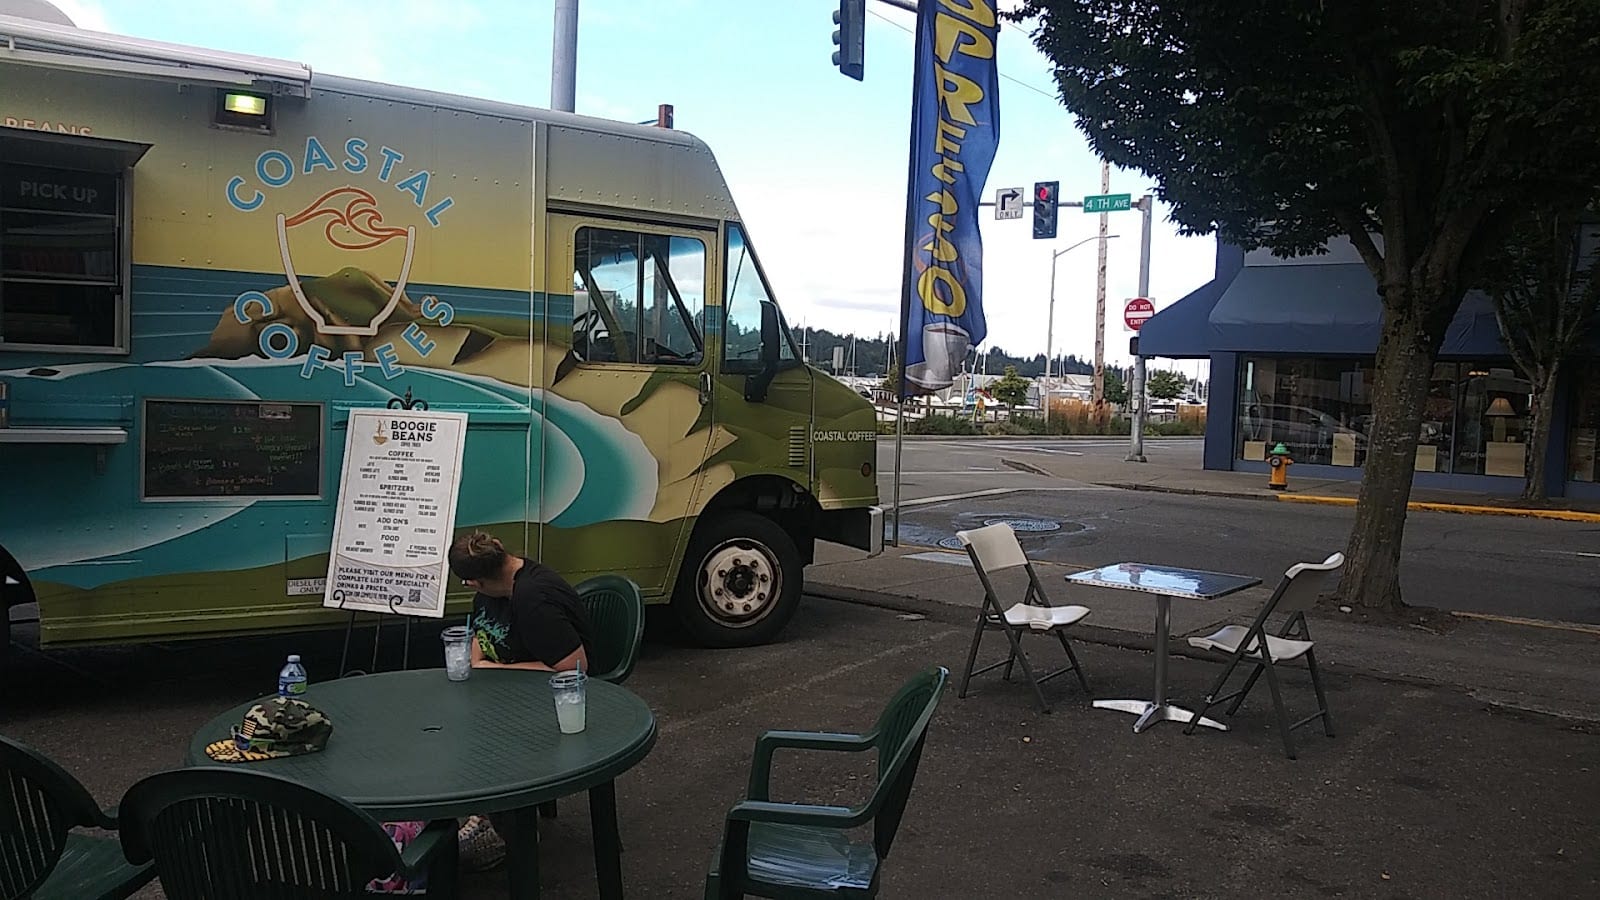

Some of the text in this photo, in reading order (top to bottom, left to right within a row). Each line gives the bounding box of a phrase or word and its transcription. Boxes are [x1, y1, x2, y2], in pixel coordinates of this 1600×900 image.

[226, 136, 455, 229] COASTAL
[20, 180, 98, 203] PICK UP
[1086, 199, 1129, 209] 4 TH AVE
[1000, 210, 1019, 218] ONLY
[234, 291, 455, 386] COFFEES
[391, 420, 437, 432] BOOGIE
[391, 431, 433, 442] BEANS
[813, 431, 846, 441] COASTAL
[379, 484, 415, 492] SPRITZERS
[380, 534, 400, 542] FOOD
[339, 567, 361, 575] PLEASE
[336, 582, 359, 590] DRINKS
[337, 574, 369, 583] COMPLETE
[370, 576, 384, 584] LIST
[395, 579, 430, 588] SPECIALTY
